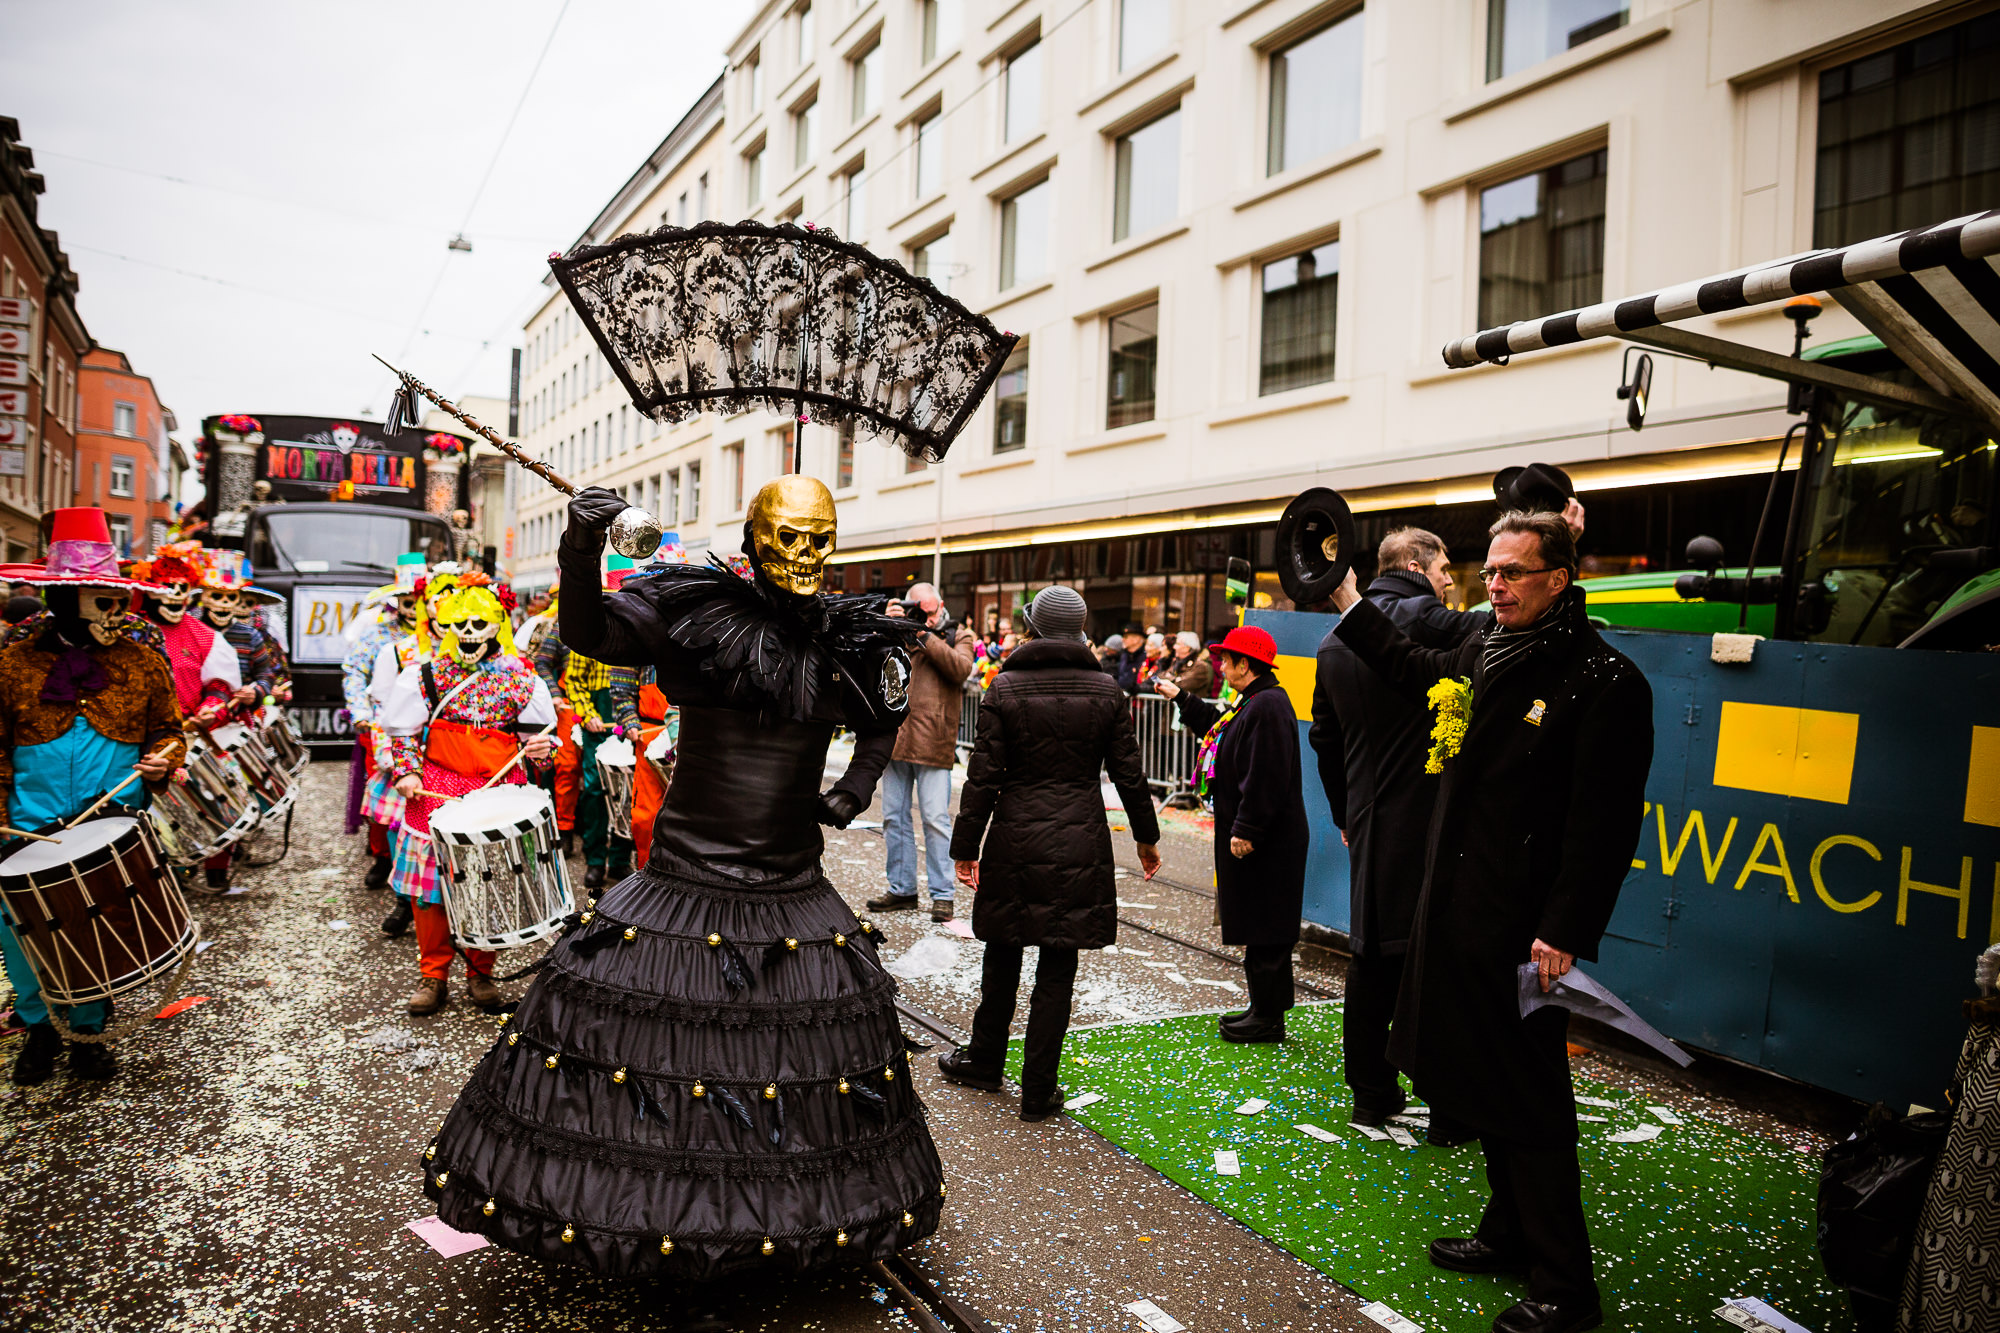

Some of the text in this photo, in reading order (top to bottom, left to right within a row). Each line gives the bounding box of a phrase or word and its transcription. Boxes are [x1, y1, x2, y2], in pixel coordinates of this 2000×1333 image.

[267, 445, 416, 489] MORTA BELLA
[288, 707, 354, 735] SNAC
[1631, 801, 2000, 946] WACH
